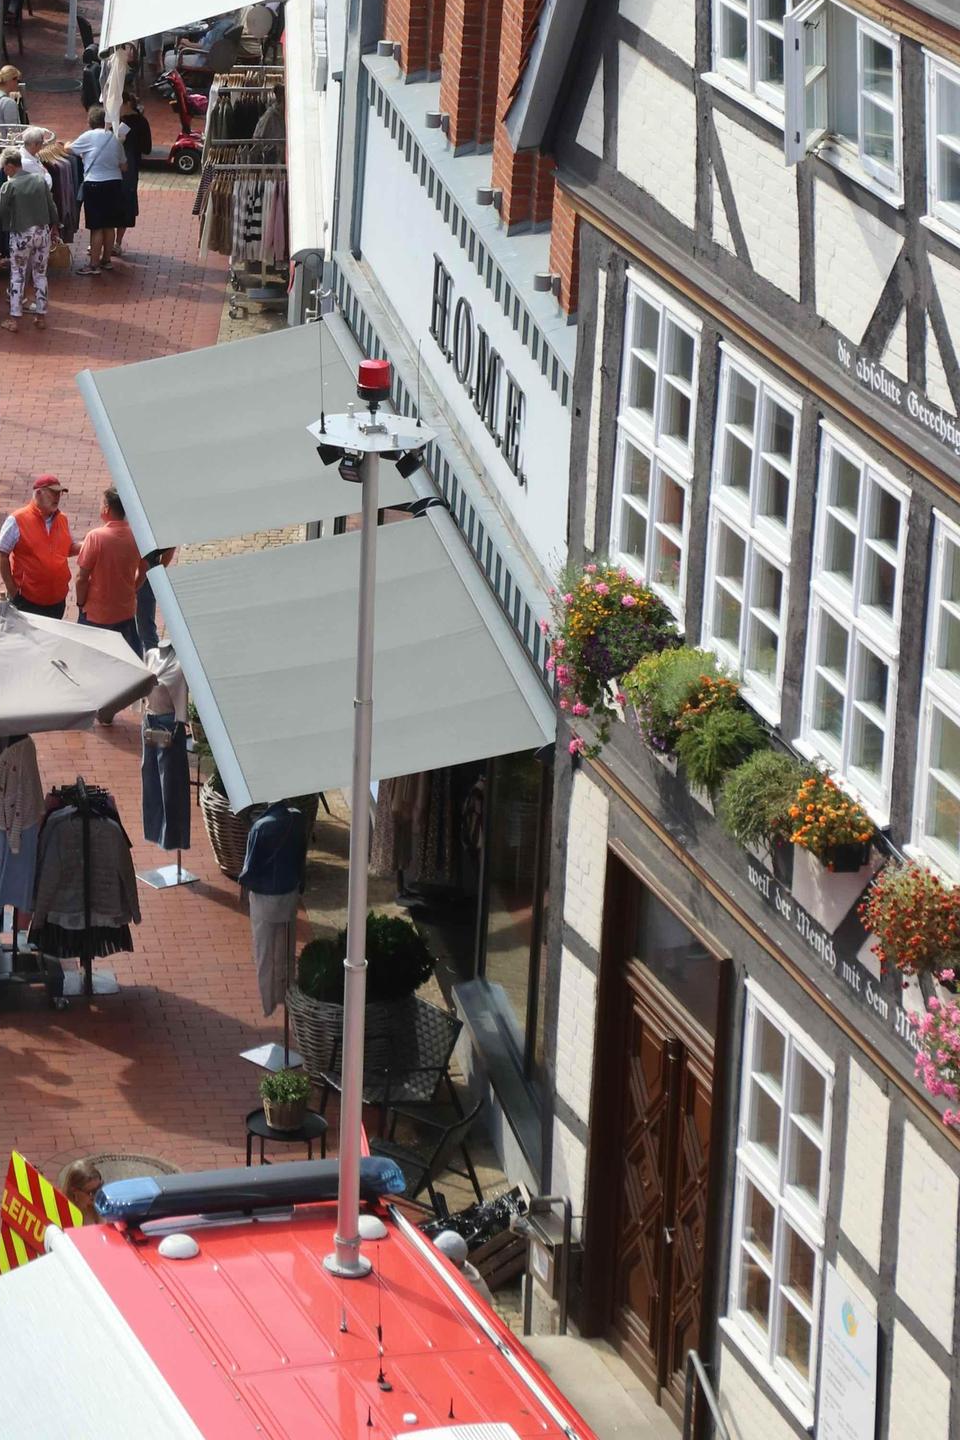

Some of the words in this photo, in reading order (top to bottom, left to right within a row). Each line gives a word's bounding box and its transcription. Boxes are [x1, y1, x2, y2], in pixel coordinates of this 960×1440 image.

[748, 865, 771, 898] weil
[775, 887, 792, 921] der
[843, 961, 861, 992] mit
[865, 980, 888, 1020] dem
